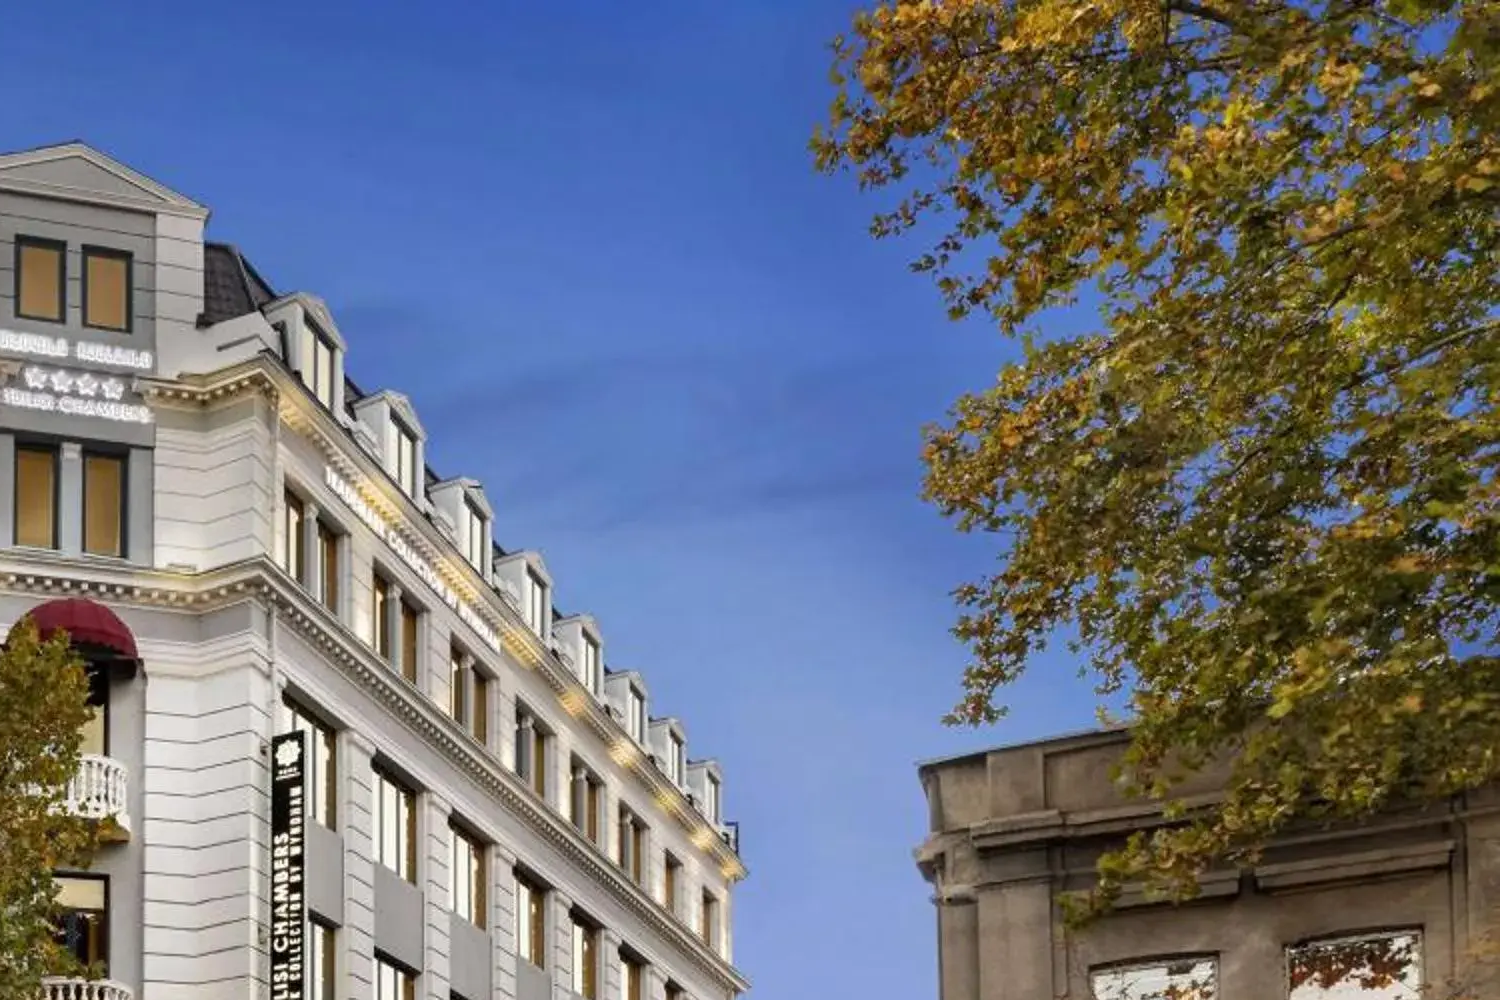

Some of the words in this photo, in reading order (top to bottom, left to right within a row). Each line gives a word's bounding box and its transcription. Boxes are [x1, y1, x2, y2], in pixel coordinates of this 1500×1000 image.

[289, 786, 302, 857] WYNDHAM
[273, 831, 289, 953] CHAMBERS
[288, 893, 301, 981] COLLECTION
